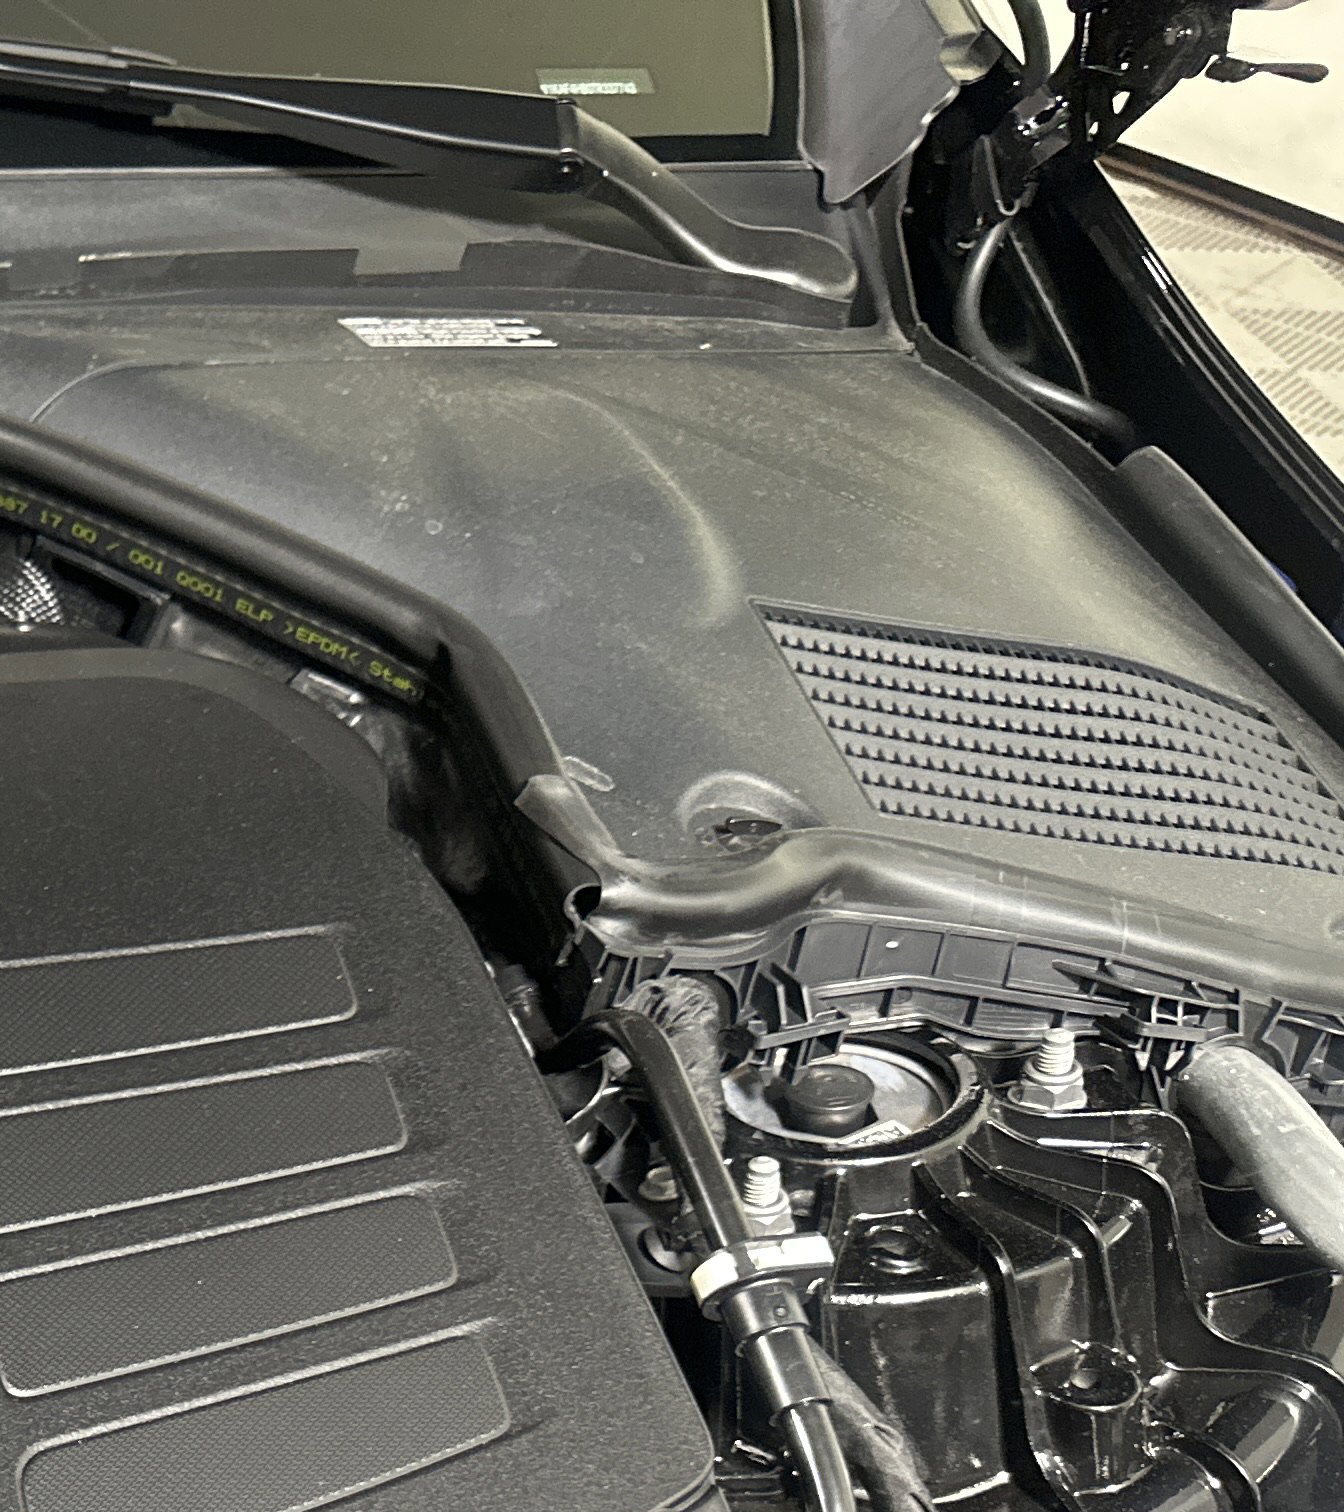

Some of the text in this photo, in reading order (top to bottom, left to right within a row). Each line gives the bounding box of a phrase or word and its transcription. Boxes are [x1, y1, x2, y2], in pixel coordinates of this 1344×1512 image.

[39, 509, 64, 529] 17
[70, 521, 98, 544] 00
[233, 597, 274, 624] ELP
